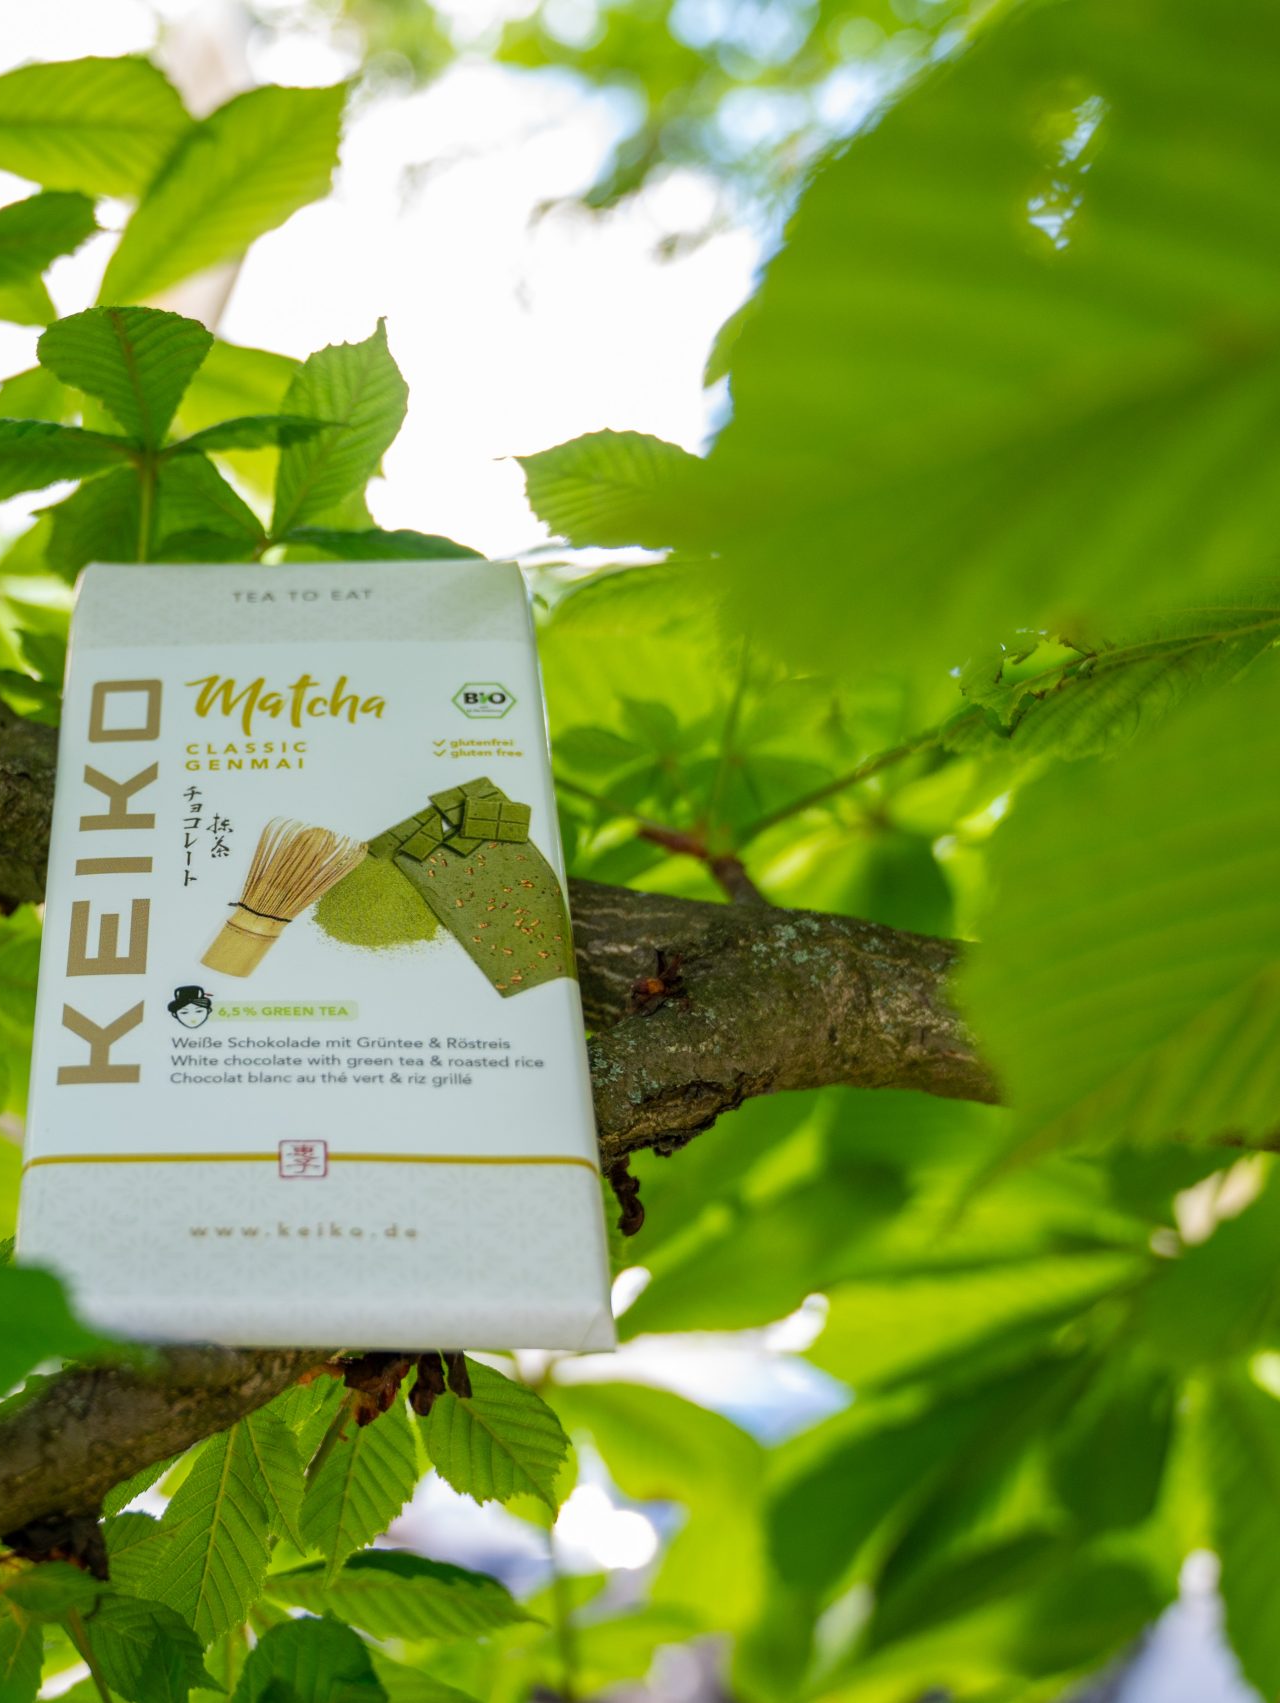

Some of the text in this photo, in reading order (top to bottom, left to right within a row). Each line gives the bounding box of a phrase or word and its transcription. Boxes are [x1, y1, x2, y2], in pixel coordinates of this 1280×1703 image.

[232, 588, 373, 604] TEA TO EAT
[184, 674, 387, 737] Matcha
[185, 741, 308, 756] CLASSIC
[449, 738, 514, 749] glutenfrei
[450, 748, 523, 759] gluten free
[184, 757, 305, 772] GENMAI
[183, 785, 203, 887] チョコレート
[56, 678, 163, 1085] KEIKO
[261, 1006, 315, 1017] GREEN
[319, 1006, 349, 1017] TEA
[171, 1036, 512, 1050] Weiße Schokolade mit Grüntee & Röstreis
[170, 1054, 546, 1069] White chocolate with green tea & roasted rice
[169, 1071, 474, 1088] Chocolat blanc au thé vert & riz grillé
[190, 1221, 419, 1239] www.keiko.de
